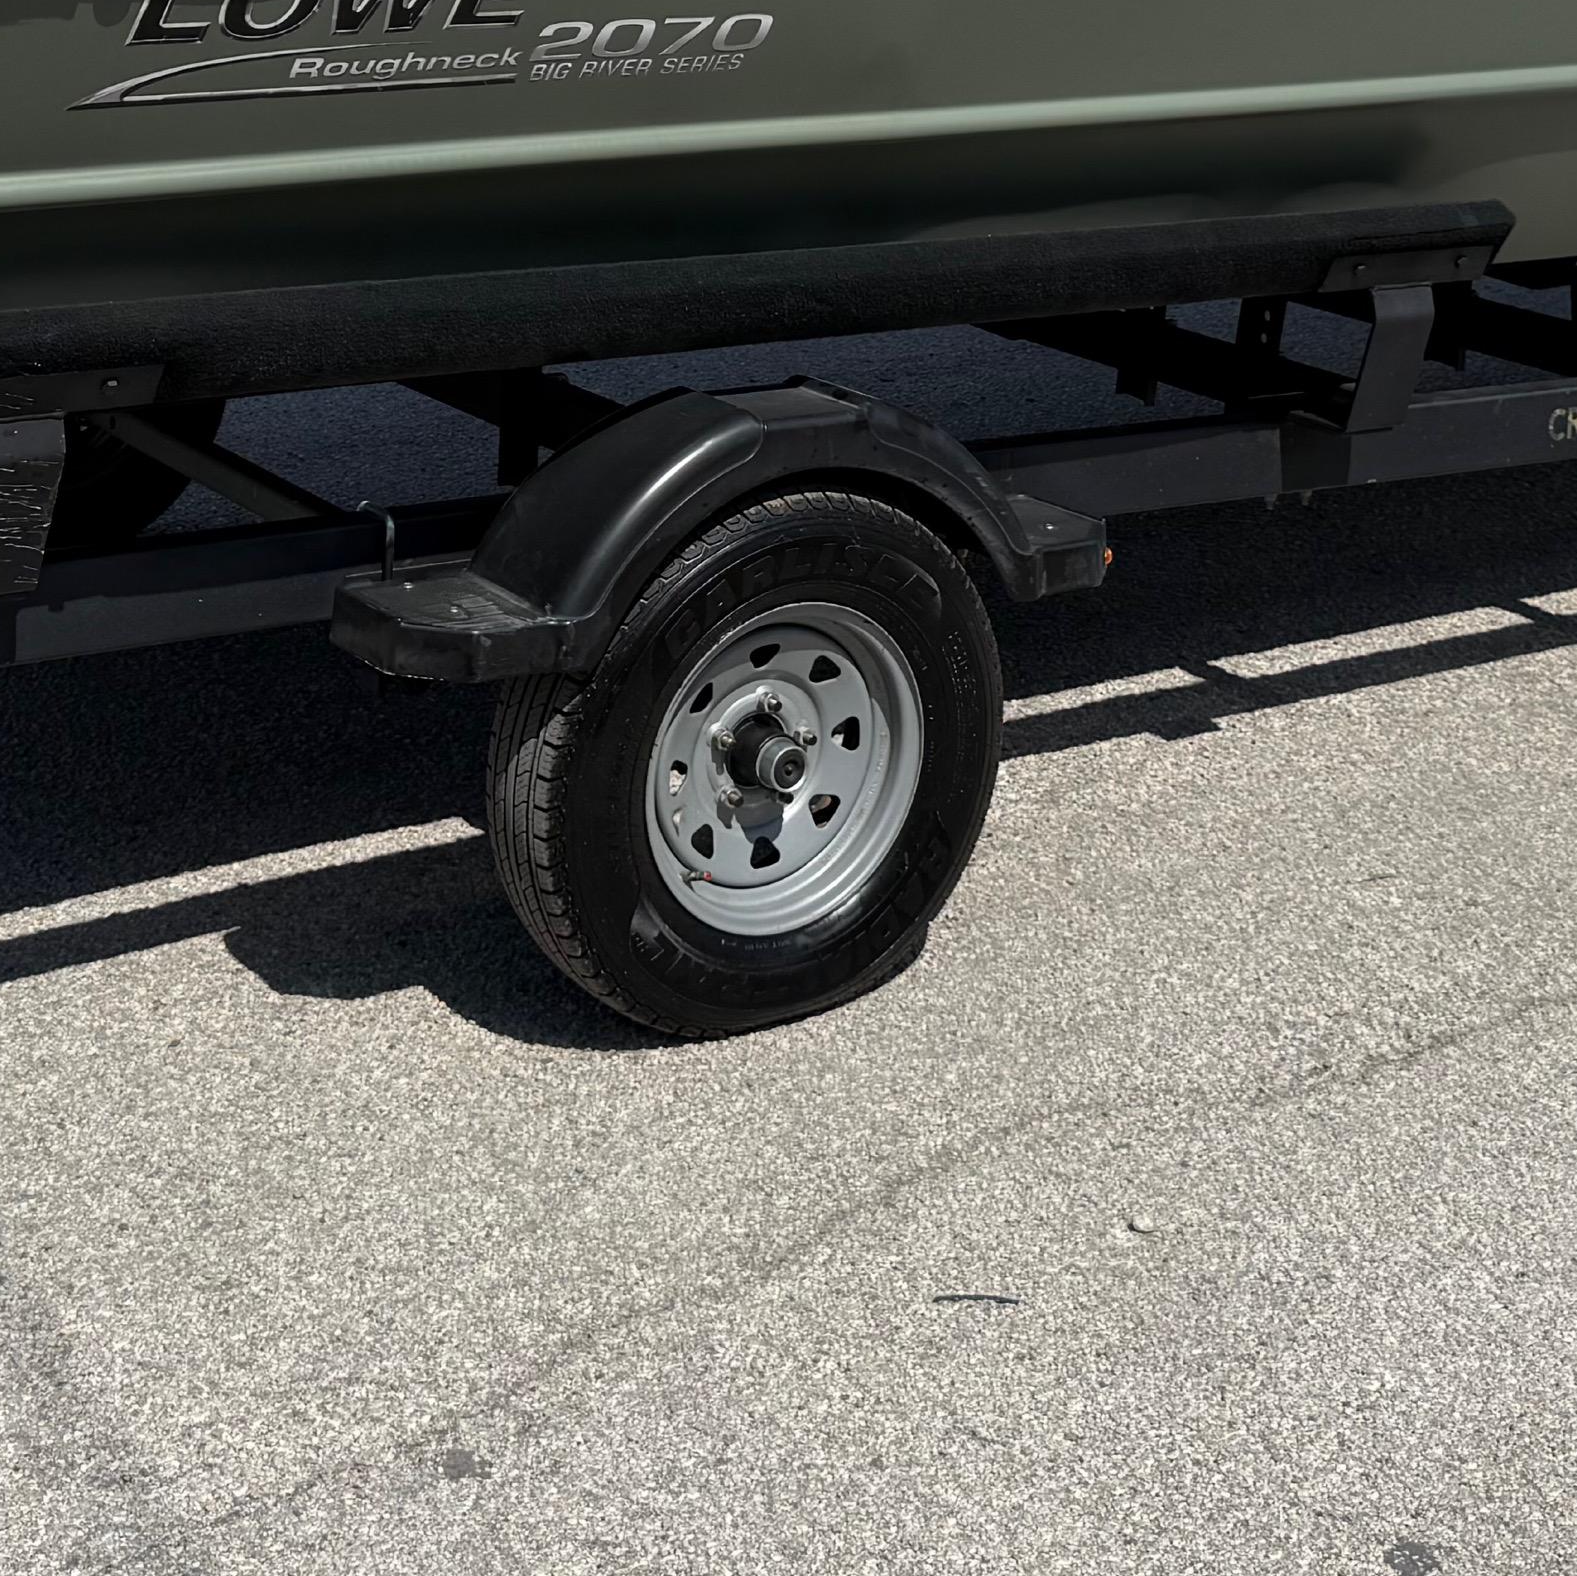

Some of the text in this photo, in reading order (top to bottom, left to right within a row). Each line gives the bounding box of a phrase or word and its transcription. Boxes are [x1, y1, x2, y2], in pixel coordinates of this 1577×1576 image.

[289, 13, 774, 80] Roughneck 2070
[529, 52, 745, 81] BIG RIVER SERIES
